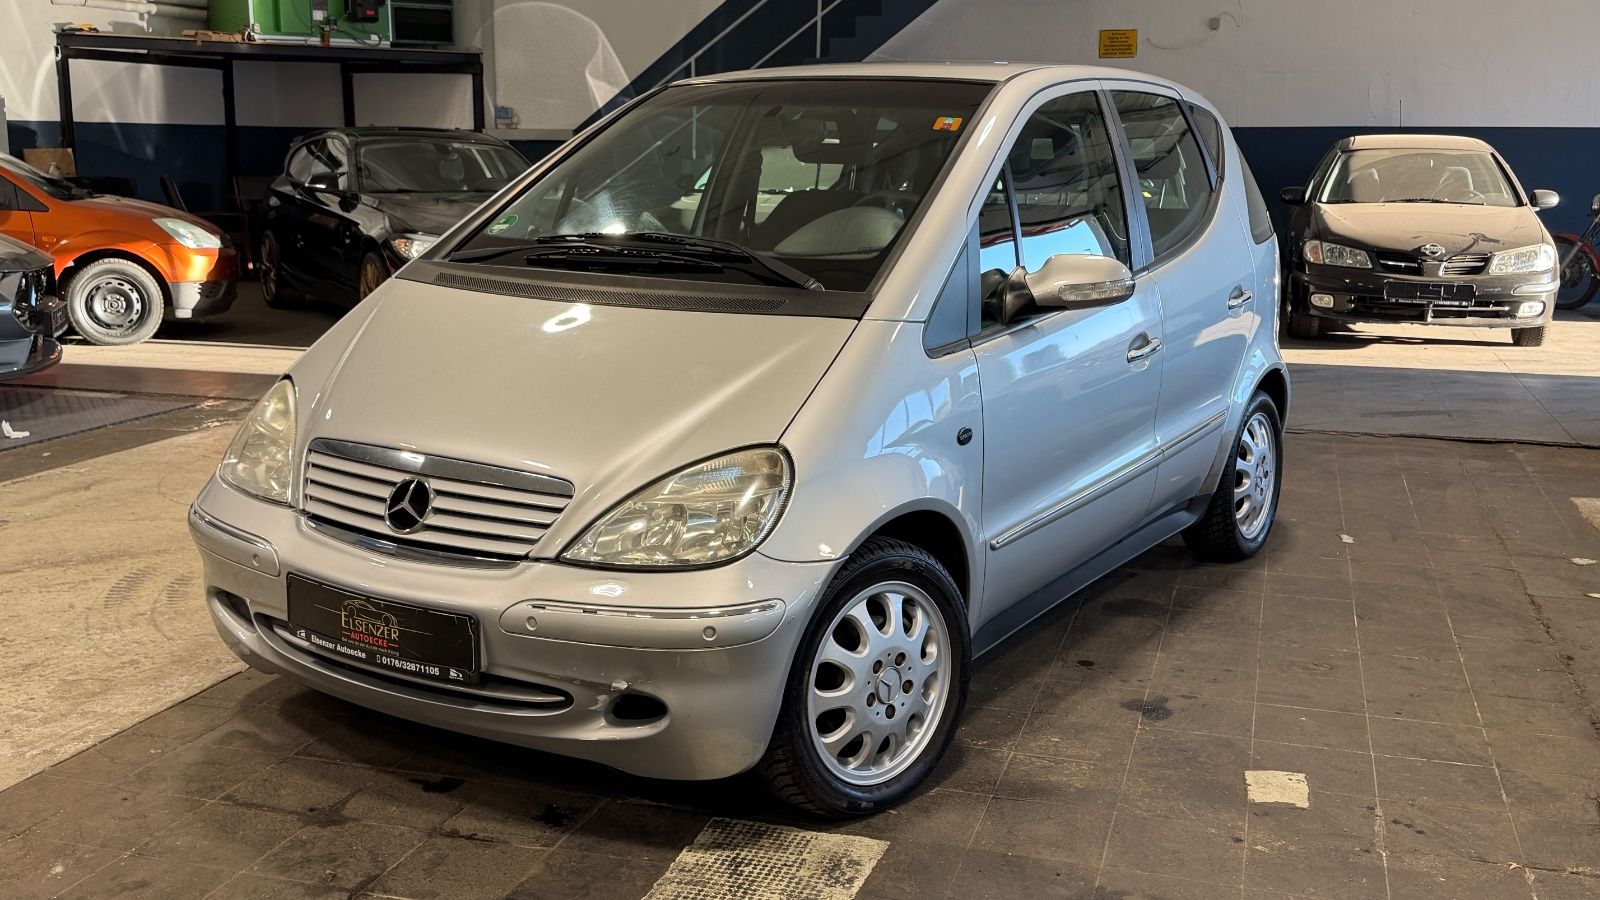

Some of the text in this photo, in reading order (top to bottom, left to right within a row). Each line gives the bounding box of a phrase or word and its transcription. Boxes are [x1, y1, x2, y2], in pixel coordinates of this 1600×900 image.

[341, 611, 400, 642] ELSENZER
[311, 634, 367, 659] Elsenzer Autoecke
[350, 632, 389, 648] AUTOECKE
[382, 656, 440, 676] 0176/32871105
